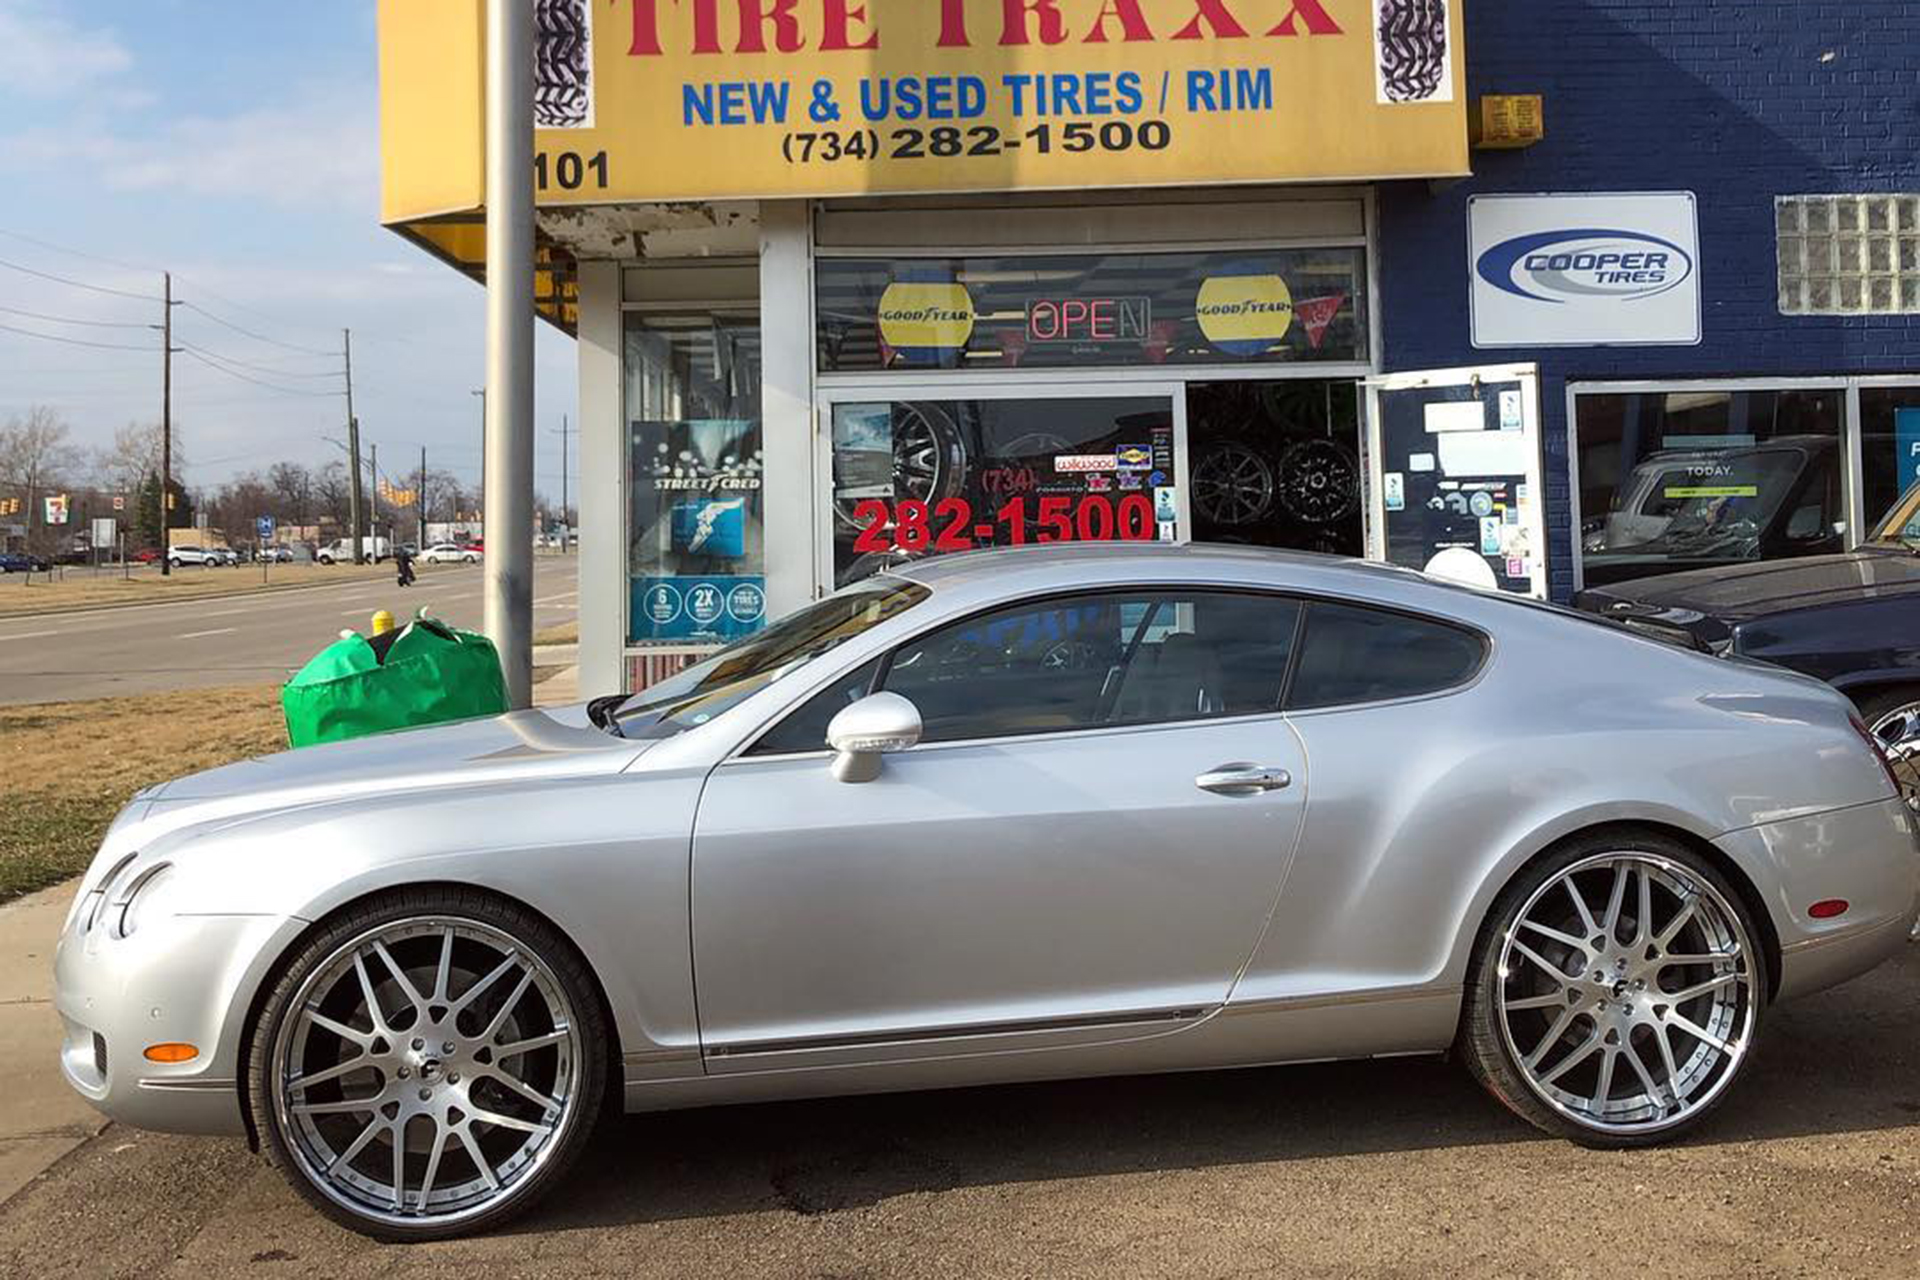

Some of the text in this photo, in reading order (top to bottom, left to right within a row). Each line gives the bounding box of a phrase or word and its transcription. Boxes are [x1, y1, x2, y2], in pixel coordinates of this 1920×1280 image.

[682, 68, 1272, 126] NEW & USED TIRES / RIM
[783, 121, 1171, 163] (734) 282-1500
[1524, 252, 1668, 271] COOPER
[1594, 270, 1665, 284] TIRES
[1031, 300, 1145, 339] OPEN
[1686, 465, 1734, 476] TODAY.
[654, 478, 760, 490] STREET CRED
[982, 469, 1034, 493] (734)
[852, 494, 1154, 554] 282-1500
[658, 588, 668, 604] 6
[694, 588, 715, 608] 2X
